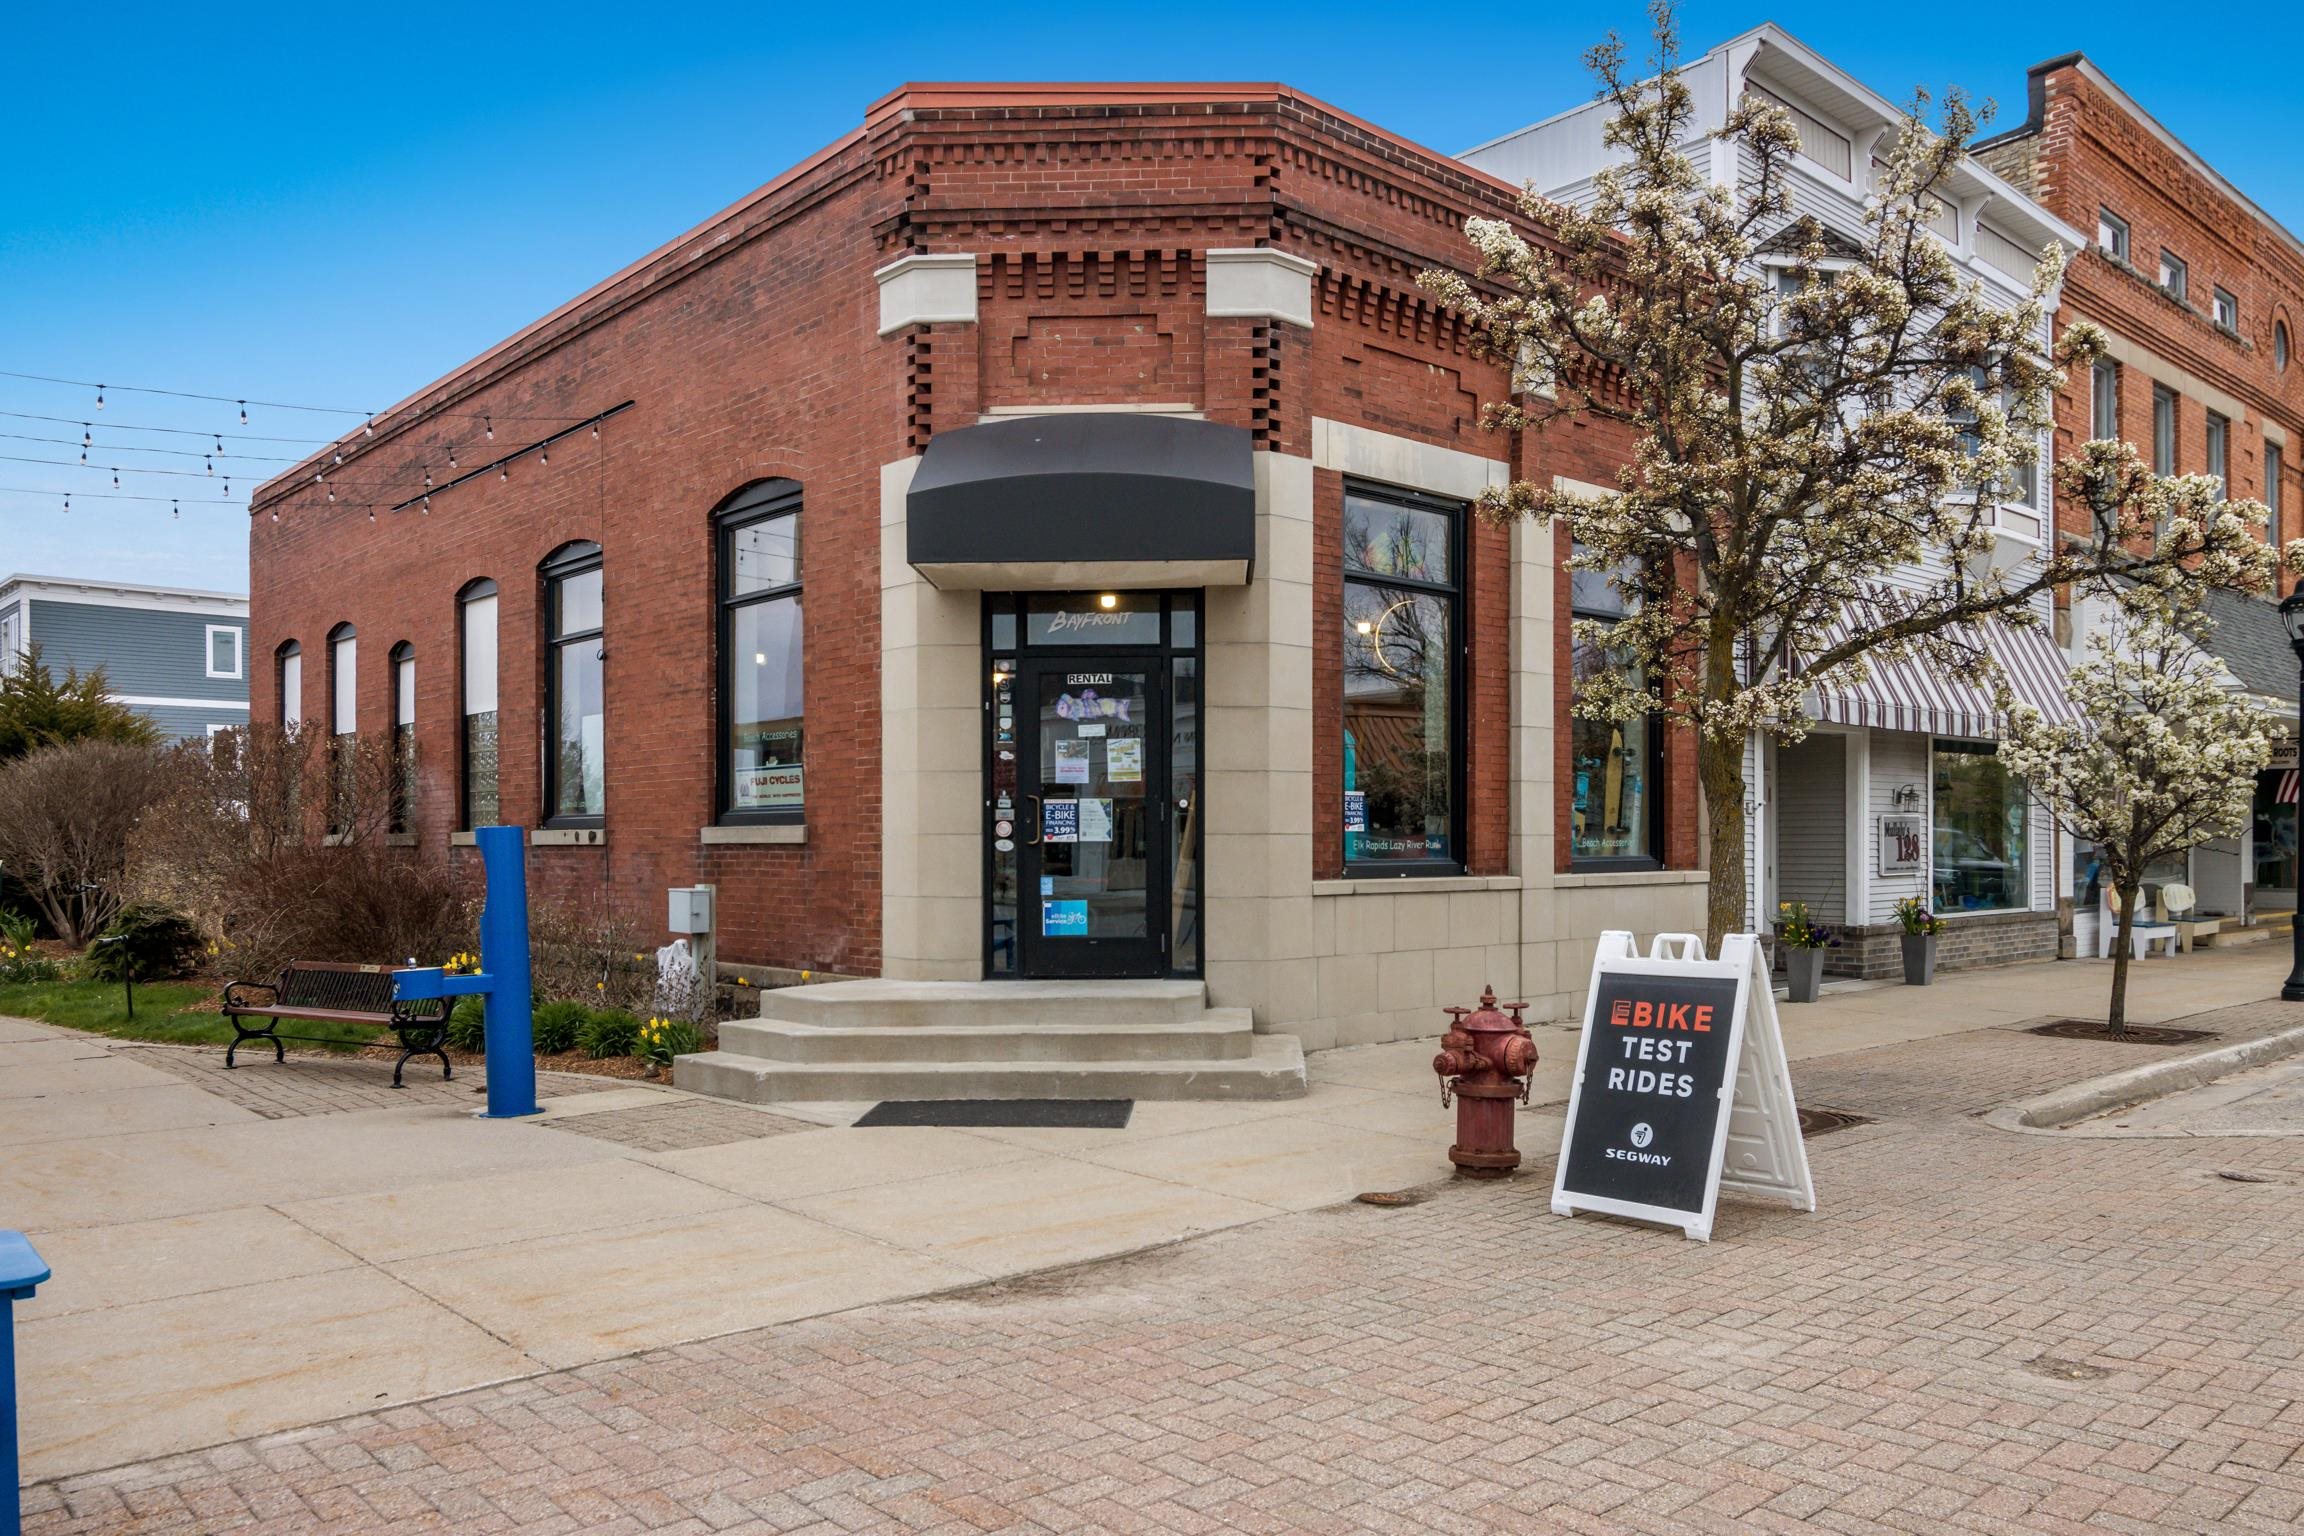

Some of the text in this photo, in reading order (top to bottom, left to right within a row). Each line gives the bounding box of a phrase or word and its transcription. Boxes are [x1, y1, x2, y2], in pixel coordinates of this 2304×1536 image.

[1047, 610, 1134, 634] BAYFRONT
[1068, 673, 1112, 684] RENTAL
[2273, 747, 2298, 758] ROOTS
[751, 774, 801, 786] FUJI CYCLES
[1344, 801, 1364, 811] E-BIKE
[1045, 810, 1076, 820] E-BIKE
[1054, 826, 1076, 834] 3.99%
[1353, 839, 1365, 850] Elk
[1365, 839, 1389, 852] Rapids
[1390, 839, 1406, 852] Lazy
[1406, 839, 1424, 849] River
[1896, 833, 1920, 862] 128
[1610, 999, 1714, 1033] EBIKE
[1622, 1035, 1693, 1064] TEST
[1607, 1067, 1695, 1098] RIDES
[1605, 1147, 1672, 1168] SEGWAY
